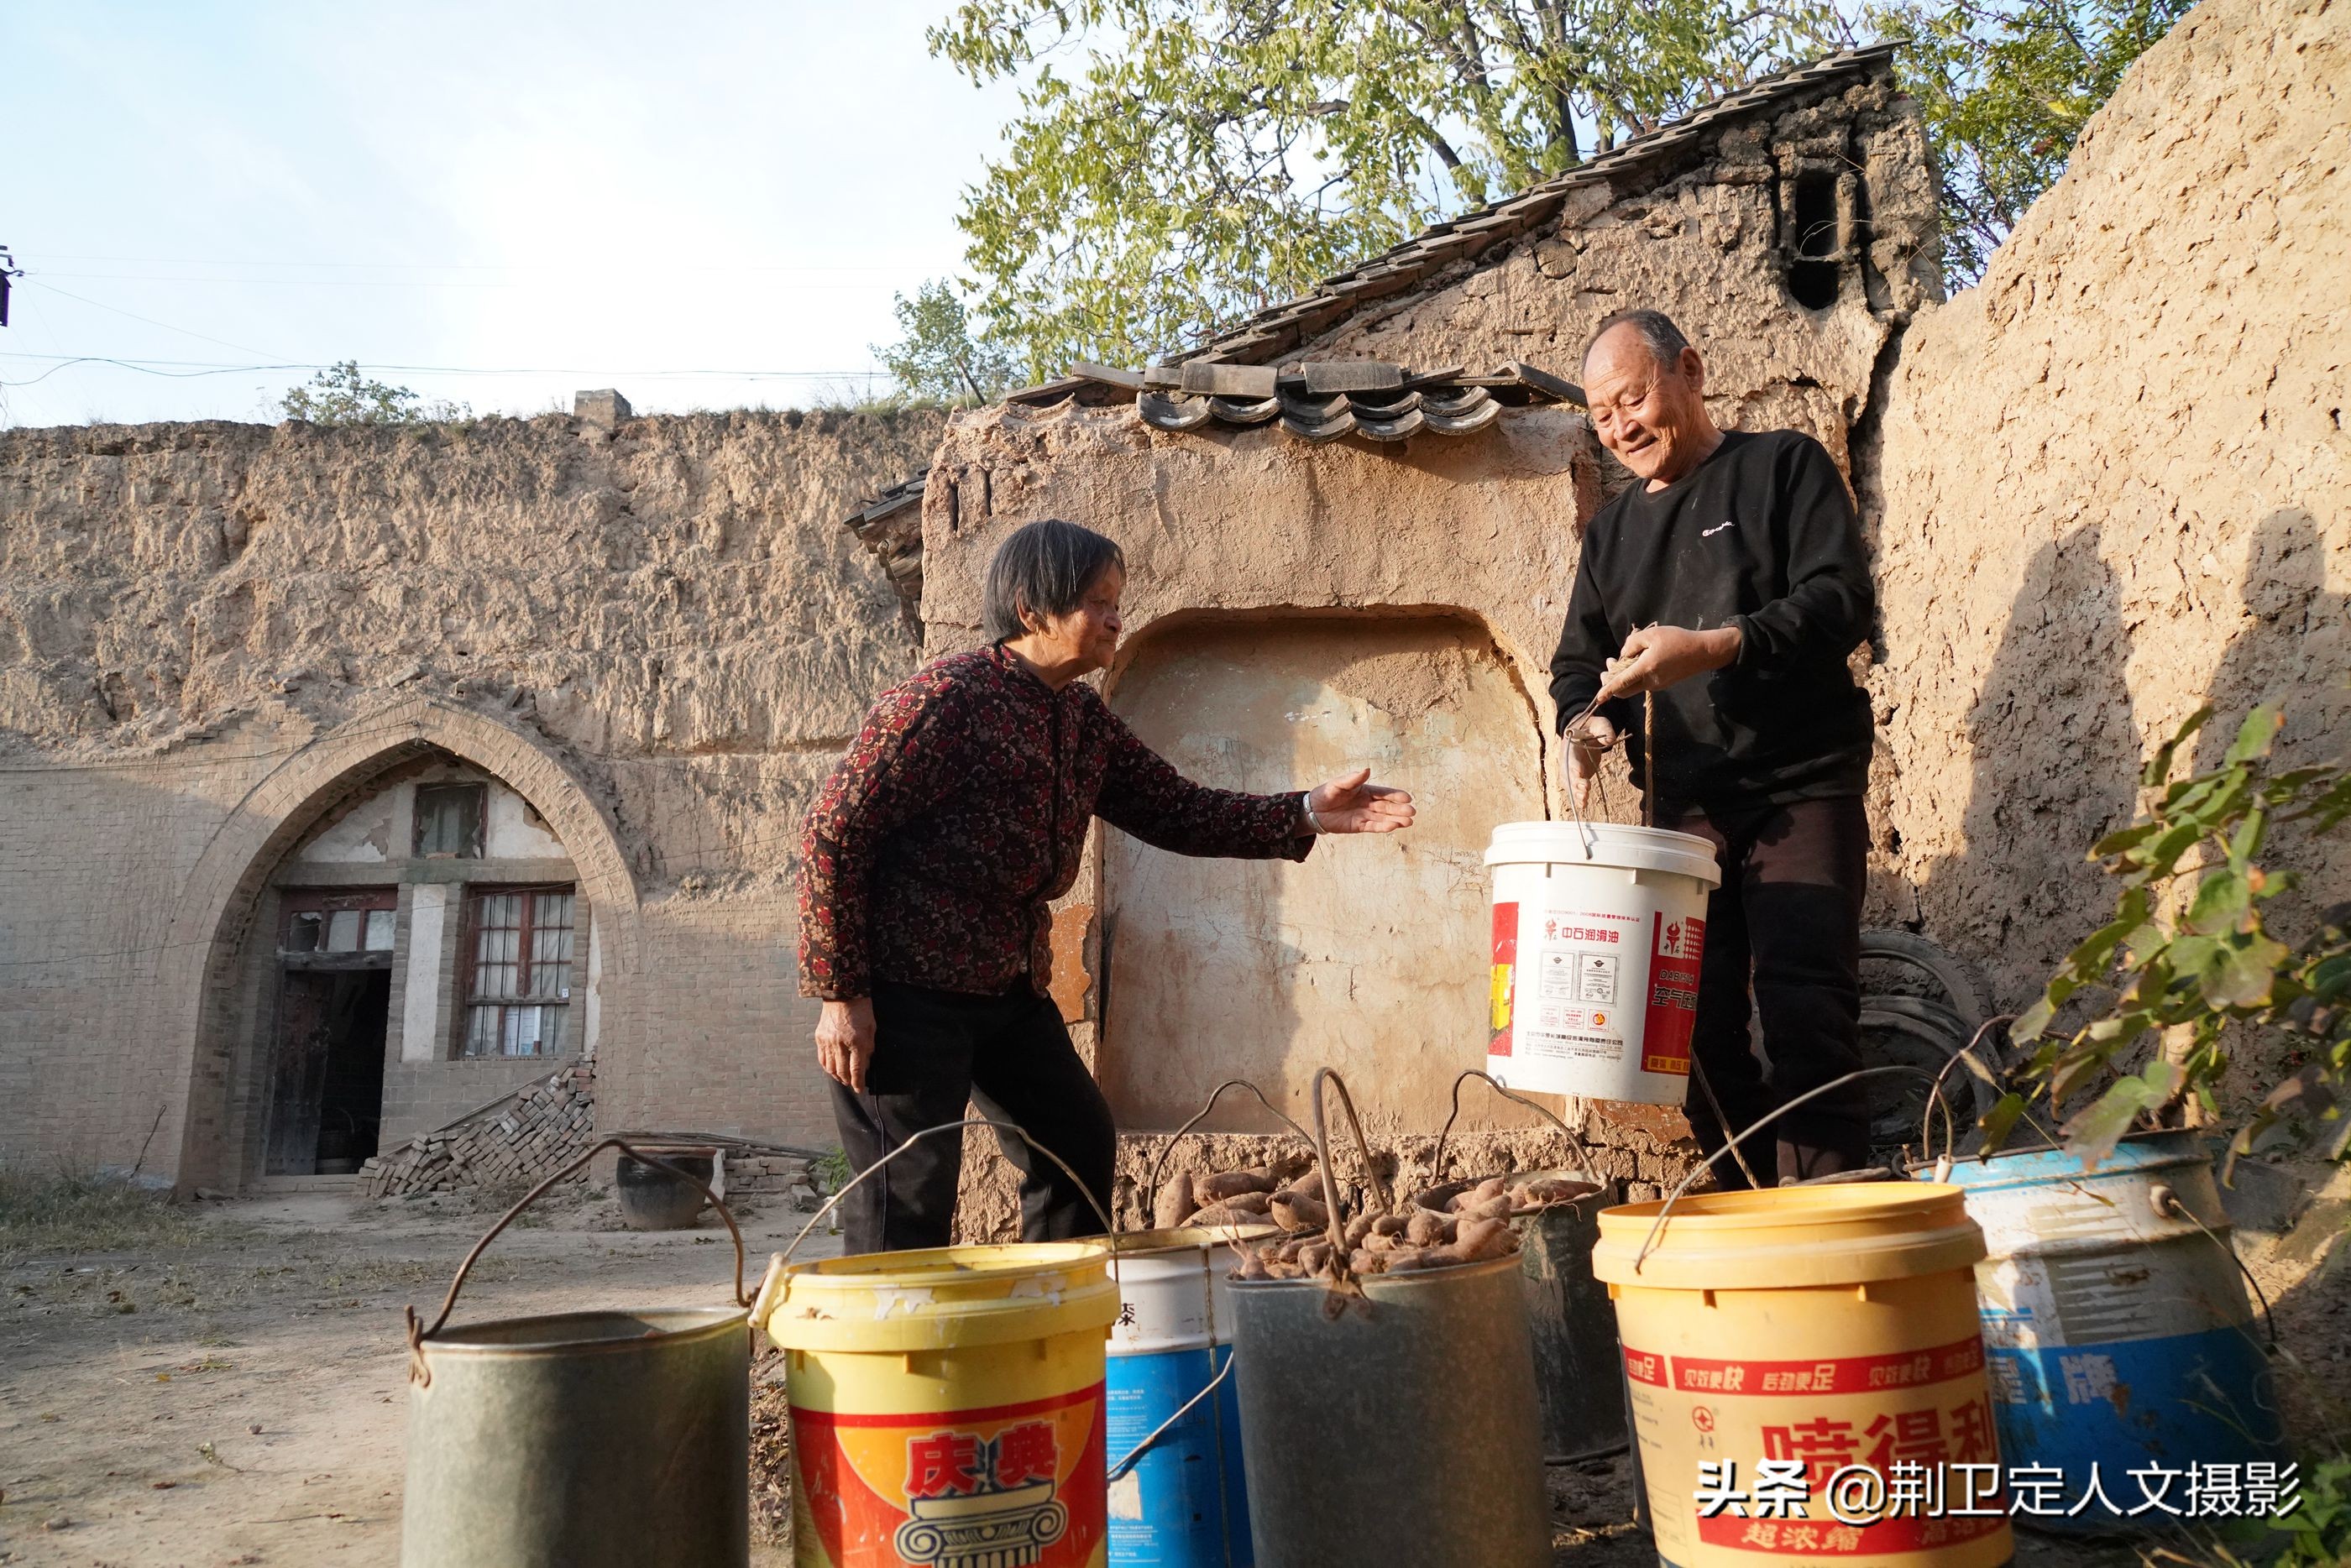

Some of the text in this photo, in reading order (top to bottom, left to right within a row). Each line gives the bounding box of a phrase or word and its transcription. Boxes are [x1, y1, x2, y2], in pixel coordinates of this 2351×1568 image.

[1562, 927, 1619, 943] 中石润滑油
[1762, 1363, 1835, 1391] 后劲更足
[905, 1423, 1056, 1497] 庆典
[1741, 1521, 1864, 1552] 超浓缩
